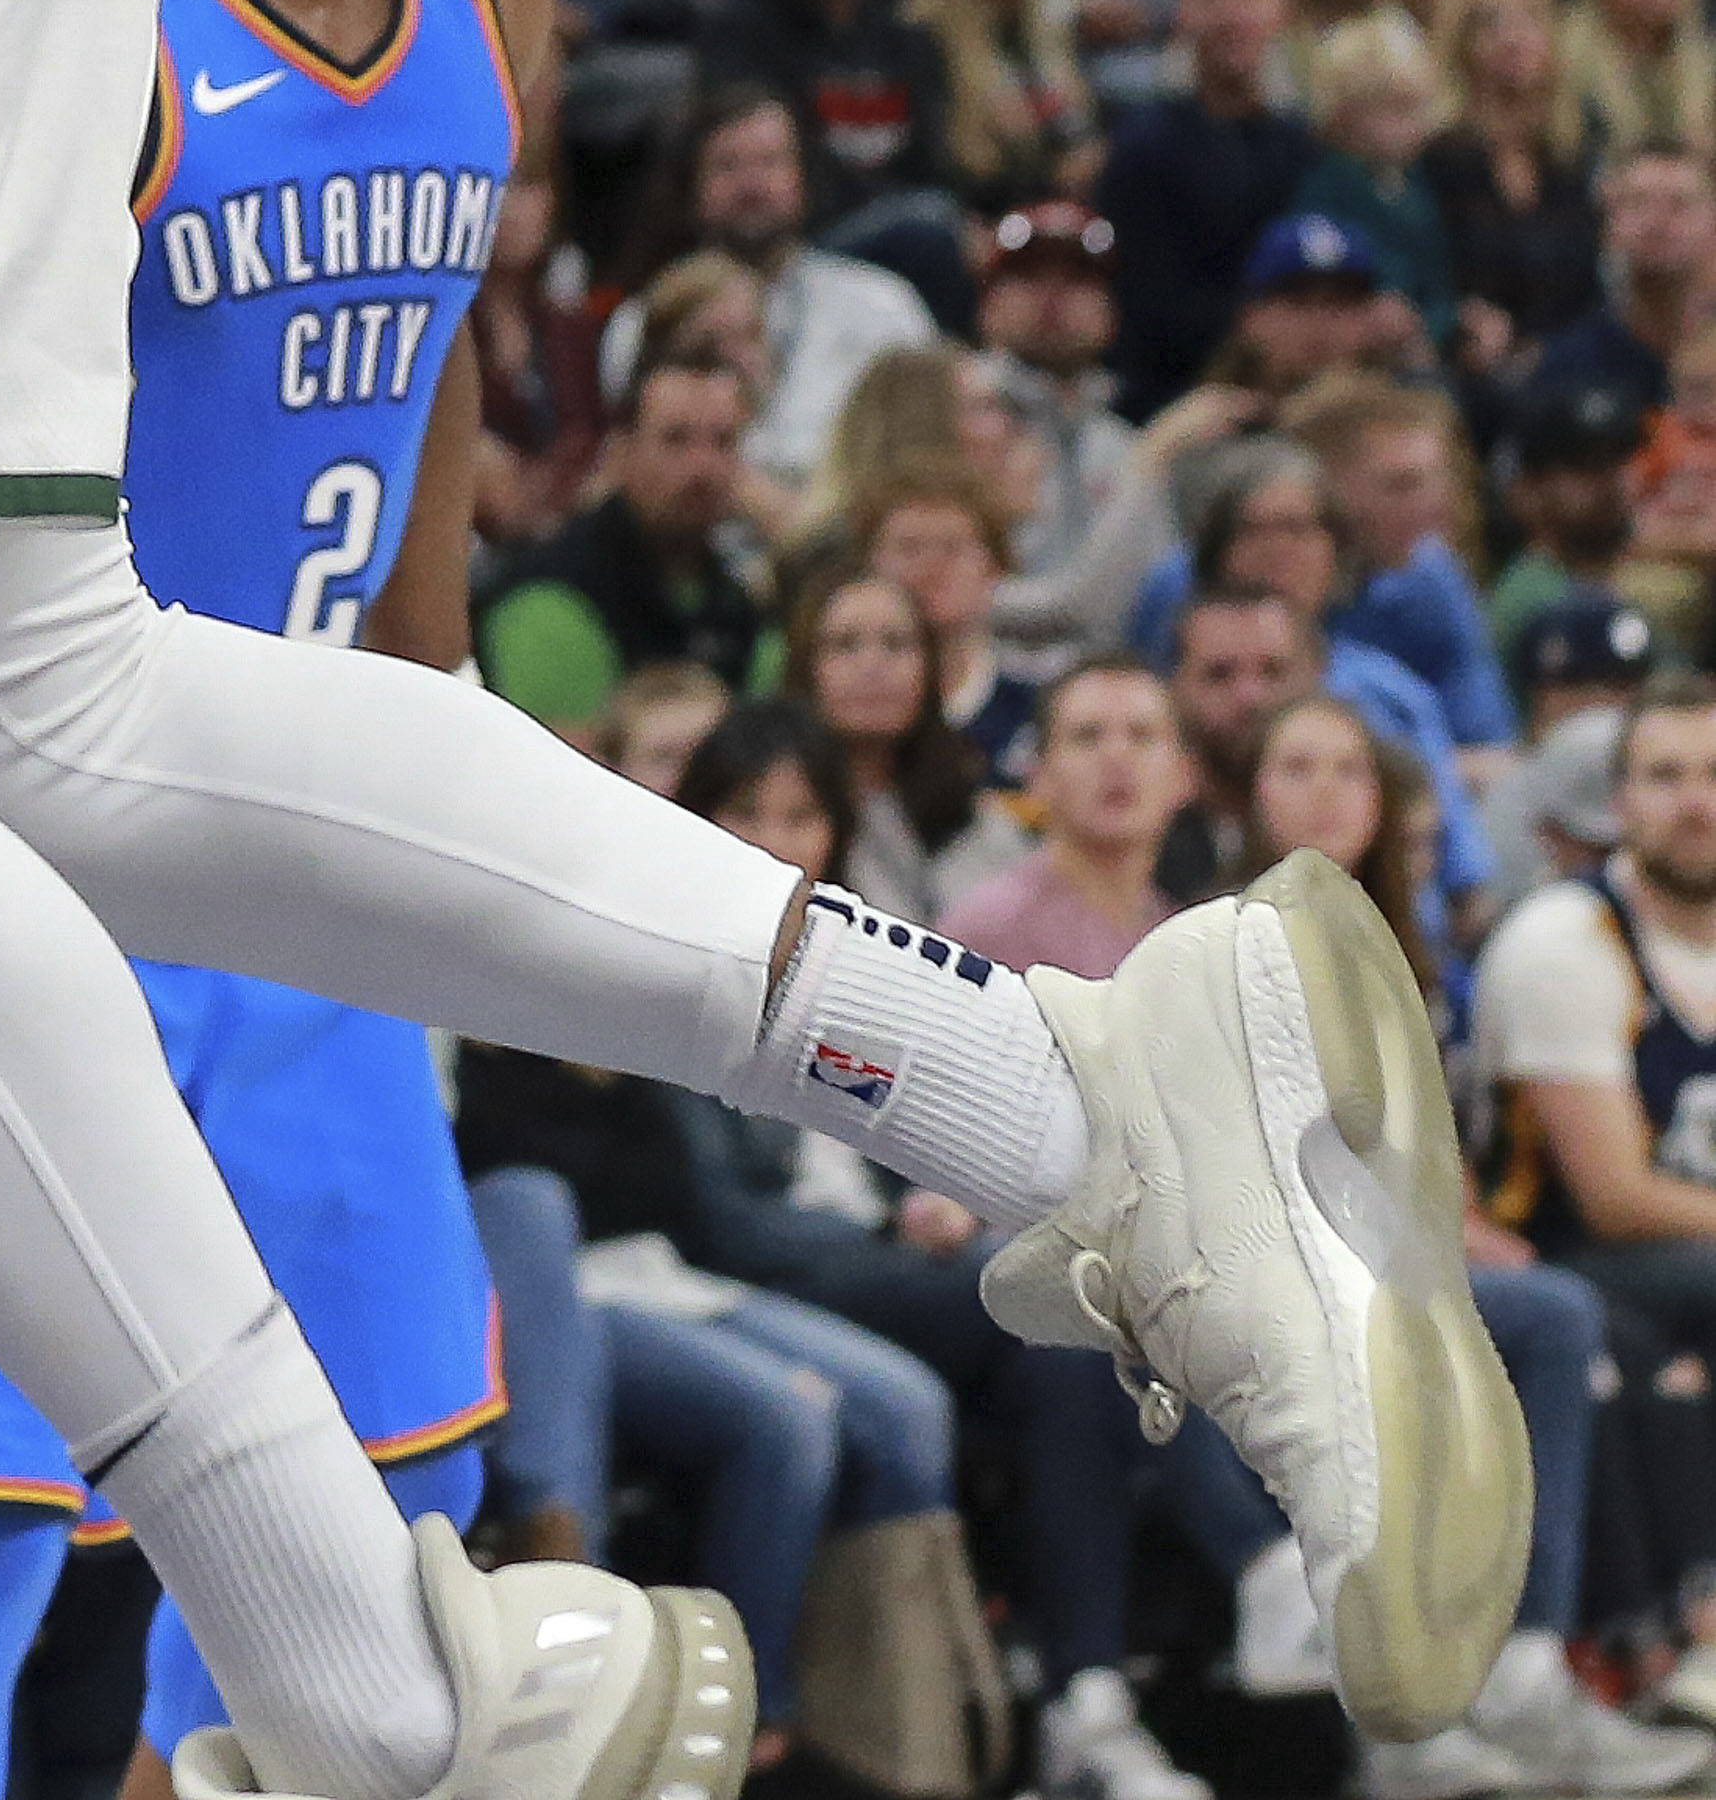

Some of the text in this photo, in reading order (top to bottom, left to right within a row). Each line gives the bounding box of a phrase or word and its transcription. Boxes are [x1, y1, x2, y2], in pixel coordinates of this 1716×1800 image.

[165, 171, 496, 306] OKLAHOM
[280, 300, 431, 409] CITY
[284, 460, 385, 649] 2
